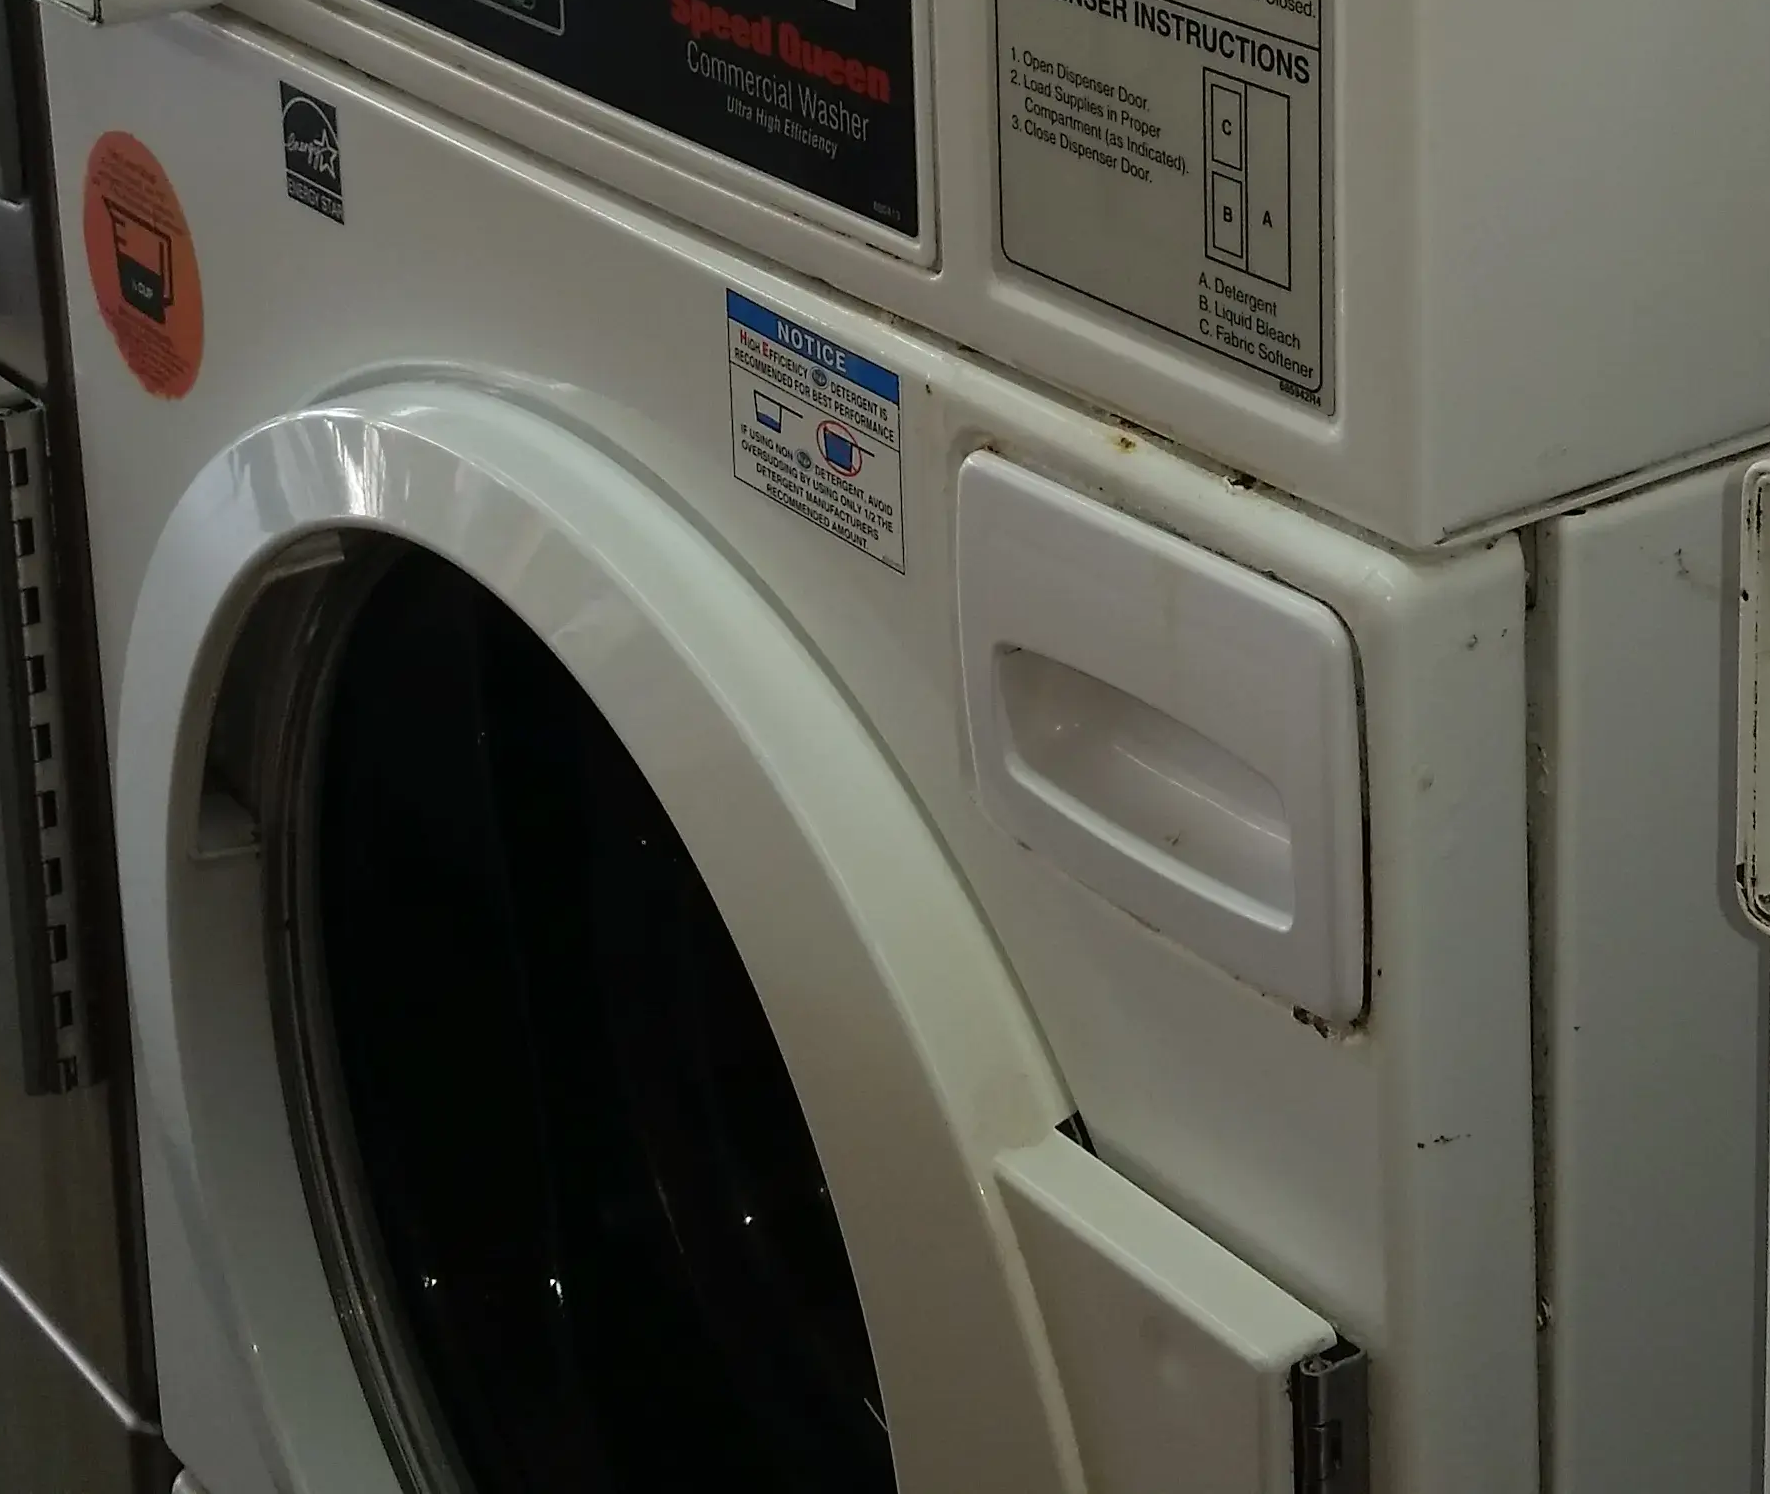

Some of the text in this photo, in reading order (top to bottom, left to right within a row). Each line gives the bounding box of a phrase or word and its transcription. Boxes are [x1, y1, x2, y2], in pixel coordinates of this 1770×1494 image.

[778, 21, 891, 105] Queen
[1134, 0, 1310, 85] INSTRUCTIONS
[687, 40, 870, 142] Commercial Washer
[1010, 69, 1162, 139] 2. Load Supplies in Proper
[1011, 46, 1150, 112] 1. Open Dispenser Door.
[727, 95, 839, 160] Ultra High Efficiency
[1011, 114, 1153, 184] 3. Close Dispenser Door.
[1024, 96, 1189, 176] Compartment (as Indicated).
[1221, 119, 1233, 137] C
[1222, 206, 1274, 228] B A
[1198, 272, 1278, 318] A. Detergent
[1198, 295, 1302, 351] B. Liquid Bleach
[762, 340, 809, 380] EFFICIENCY
[830, 381, 878, 415] DETERGENT
[879, 405, 889, 422] IS
[776, 321, 847, 373] NOTICE
[1198, 318, 1314, 379] C. Fabric Softener
[734, 347, 793, 390] RECOMMENDED
[794, 378, 811, 399] FOR
[812, 389, 833, 412] BEST
[834, 399, 895, 443] PERFORMANCE
[740, 424, 749, 437] IF
[749, 426, 774, 450] USING
[775, 441, 794, 461] NON
[868, 494, 894, 516] AVOID
[756, 463, 880, 541] DETERGENT MANUFACTURERS
[799, 472, 812, 489] BY
[812, 477, 839, 503] USING
[840, 492, 863, 516] ONLY
[864, 506, 878, 524] 1/2
[877, 516, 894, 534] THE
[766, 483, 830, 530] RECOMMENDED
